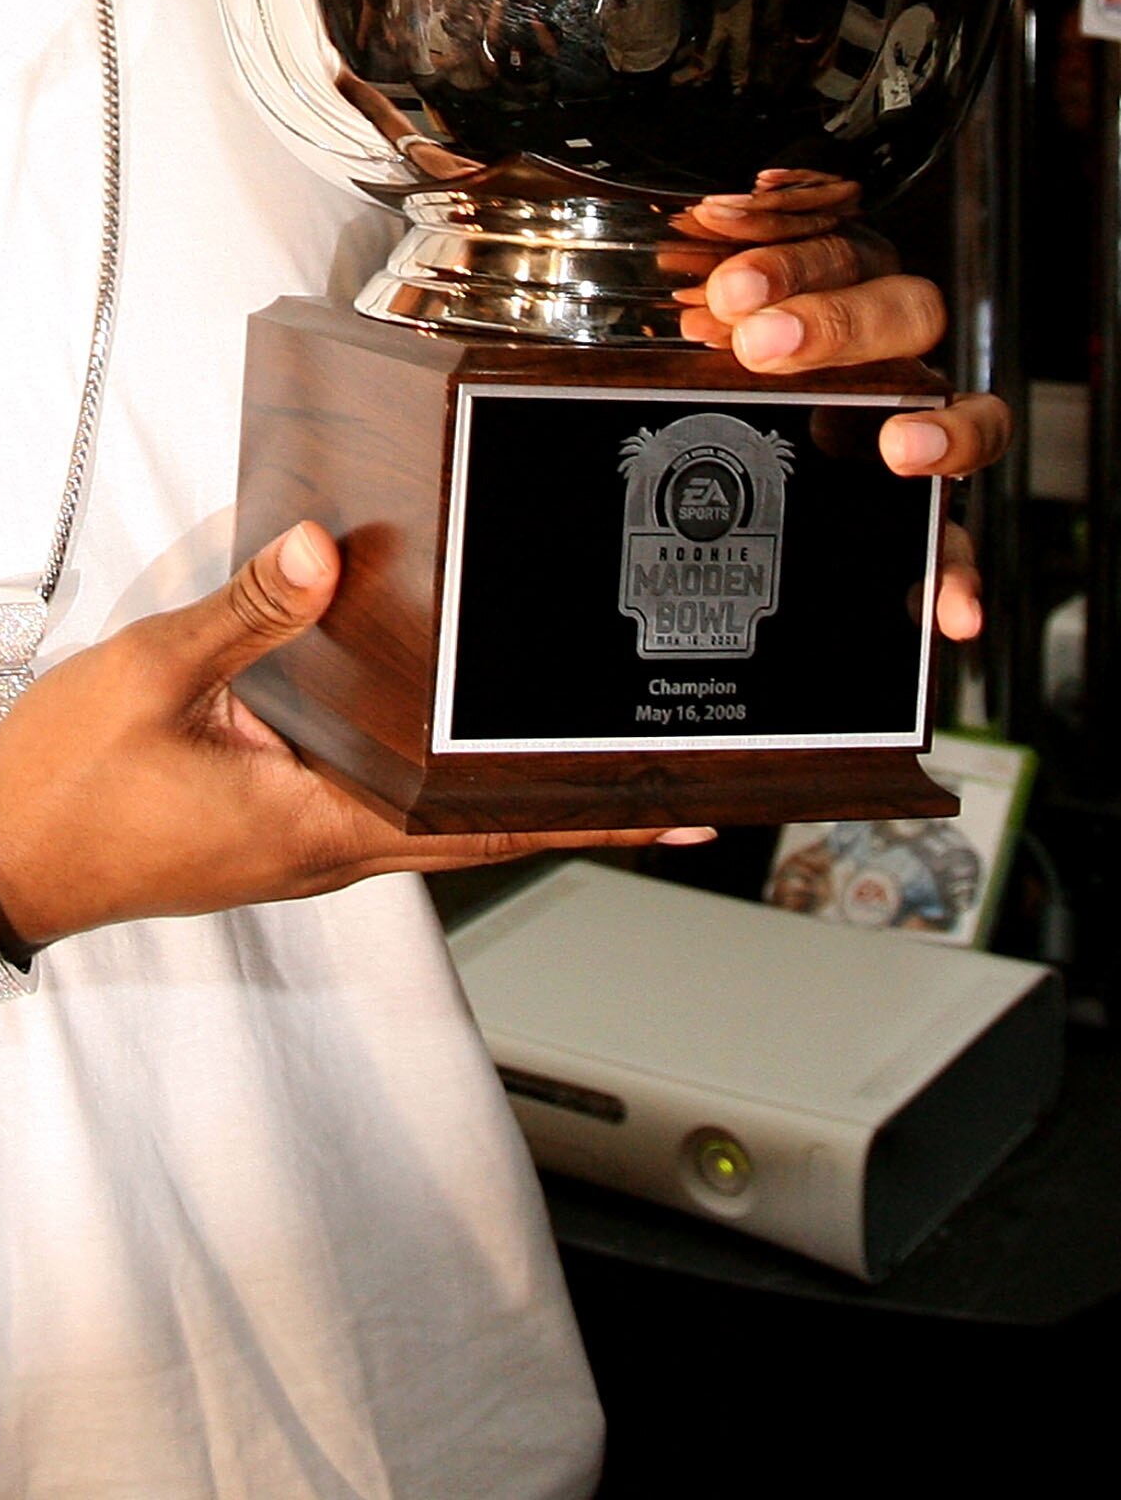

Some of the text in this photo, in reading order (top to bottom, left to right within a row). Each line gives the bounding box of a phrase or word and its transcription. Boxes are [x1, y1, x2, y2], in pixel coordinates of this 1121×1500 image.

[680, 478, 730, 506] EA
[679, 506, 731, 521] SPORTS
[660, 547, 749, 561] ROOKIE
[633, 563, 764, 596] MADDEN
[655, 600, 746, 634] BOWL
[649, 678, 737, 699] Champion
[635, 704, 747, 725] May 16, 2008
